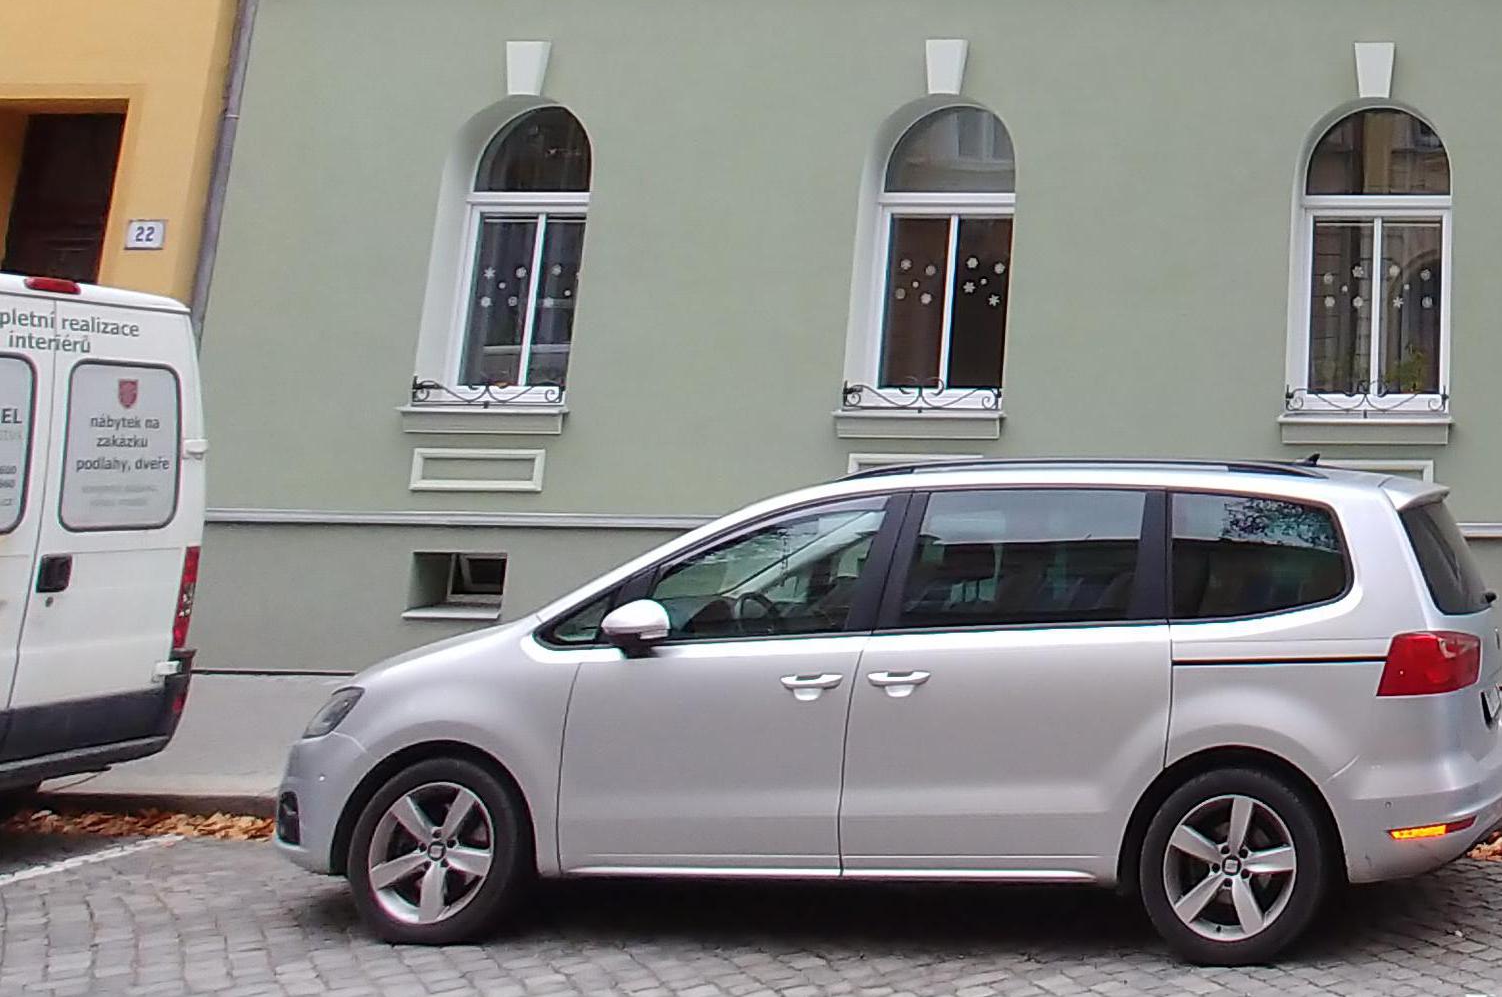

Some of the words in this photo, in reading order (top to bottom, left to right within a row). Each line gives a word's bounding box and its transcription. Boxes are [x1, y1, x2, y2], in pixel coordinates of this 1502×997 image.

[135, 225, 155, 242] 22
[61, 316, 140, 337] realizace
[8, 331, 91, 353] interiérů
[90, 414, 141, 431] nábytek
[145, 418, 160, 429] na
[96, 435, 148, 448] zakázku
[76, 457, 131, 473] podlahy,
[135, 456, 170, 470] dveře
